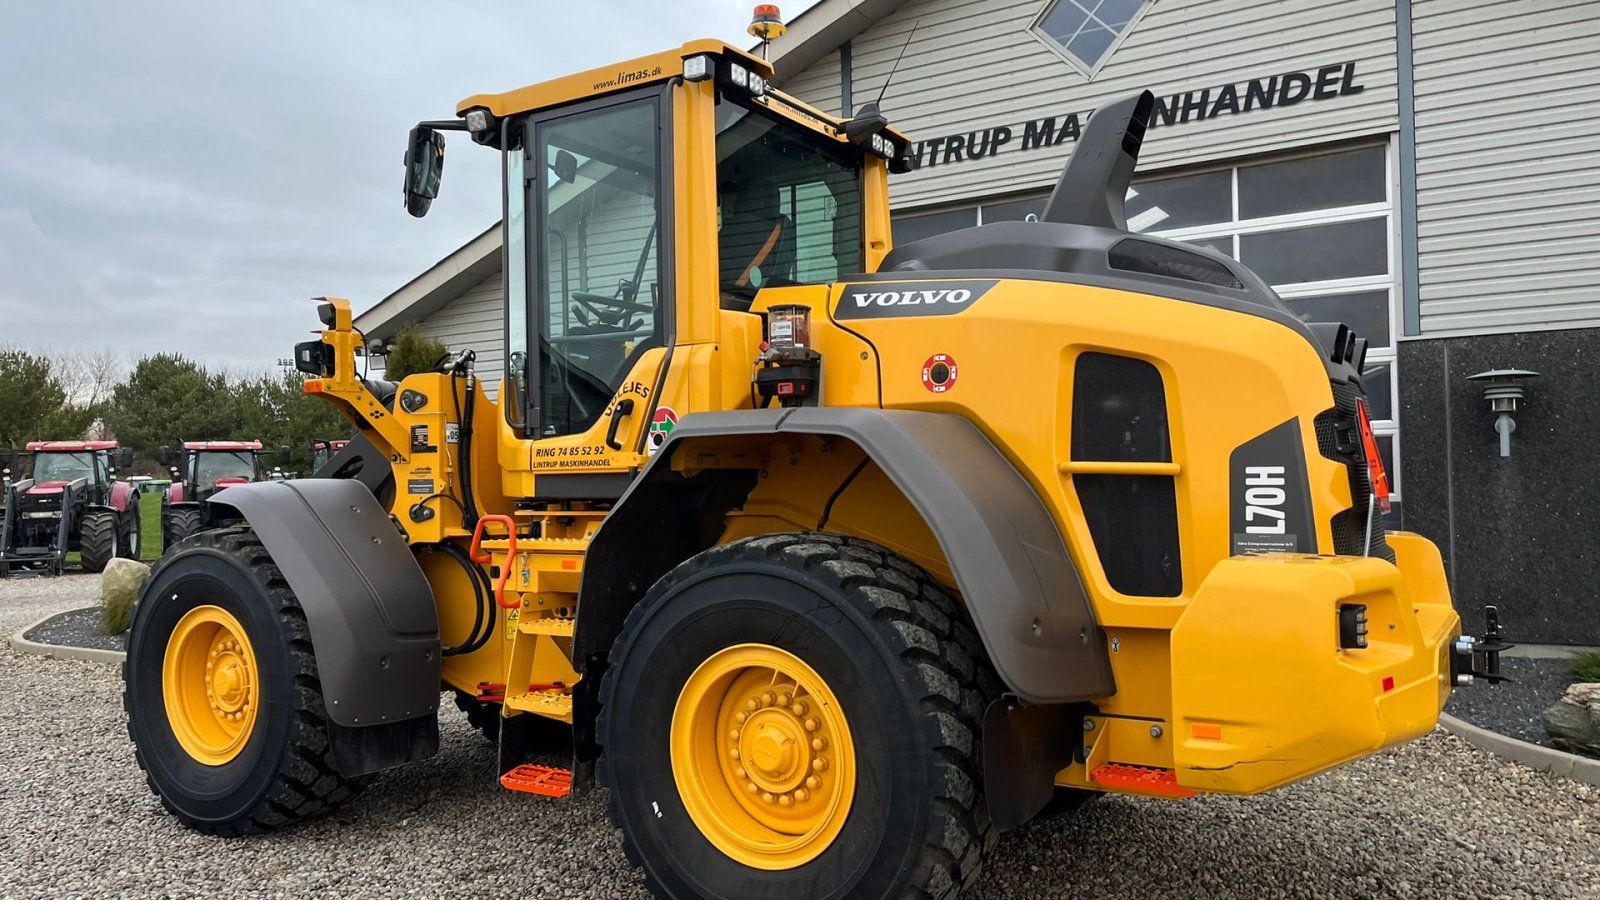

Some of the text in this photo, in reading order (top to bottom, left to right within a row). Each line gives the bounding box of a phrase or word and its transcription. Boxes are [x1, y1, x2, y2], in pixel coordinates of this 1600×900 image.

[593, 66, 662, 90] www.limas.dk
[911, 62, 1365, 170] NTRUP MANHANDEL
[852, 289, 972, 308] VOLVO
[536, 446, 605, 457] RING 74 85 52 92
[533, 459, 611, 468] LINTRUP MASKINHANDEL
[1245, 466, 1286, 534] L70H
